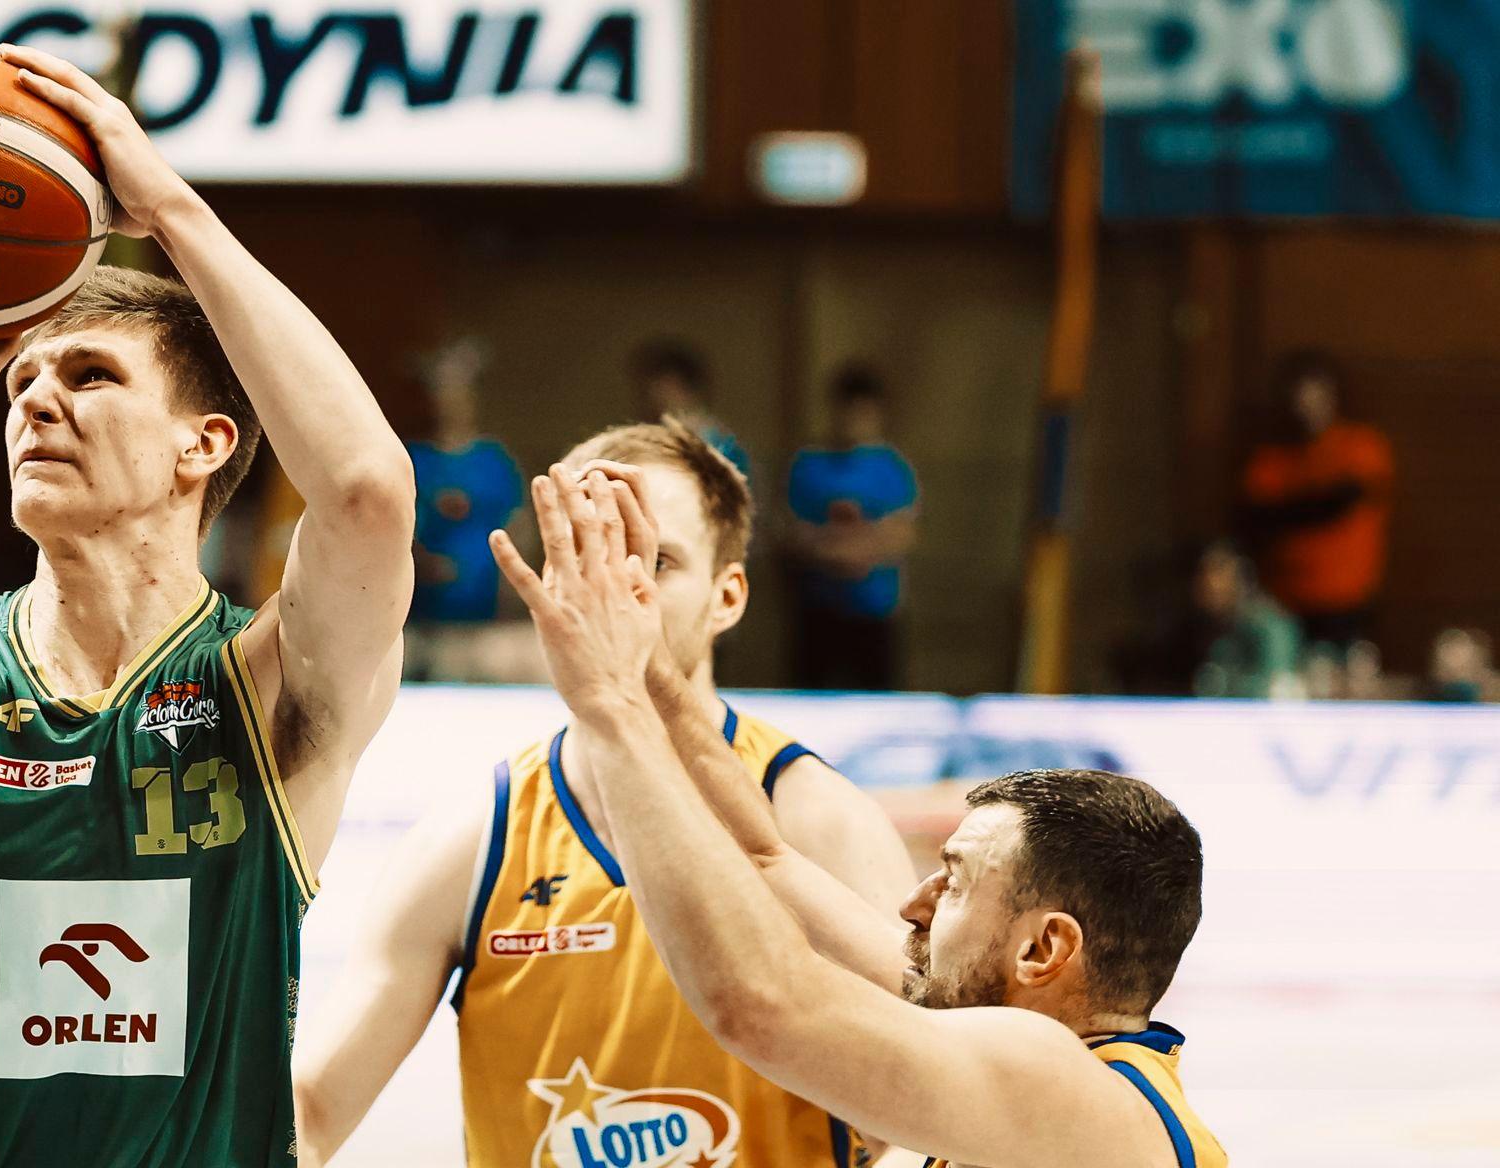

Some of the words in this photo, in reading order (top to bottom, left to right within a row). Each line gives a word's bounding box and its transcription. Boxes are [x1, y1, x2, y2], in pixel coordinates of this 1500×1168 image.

[56, 761, 92, 775] Basket
[1268, 736, 1500, 800] VIT
[132, 756, 247, 857] 13
[21, 1013, 158, 1047] ORLEN
[572, 1113, 688, 1168] LOTTO
